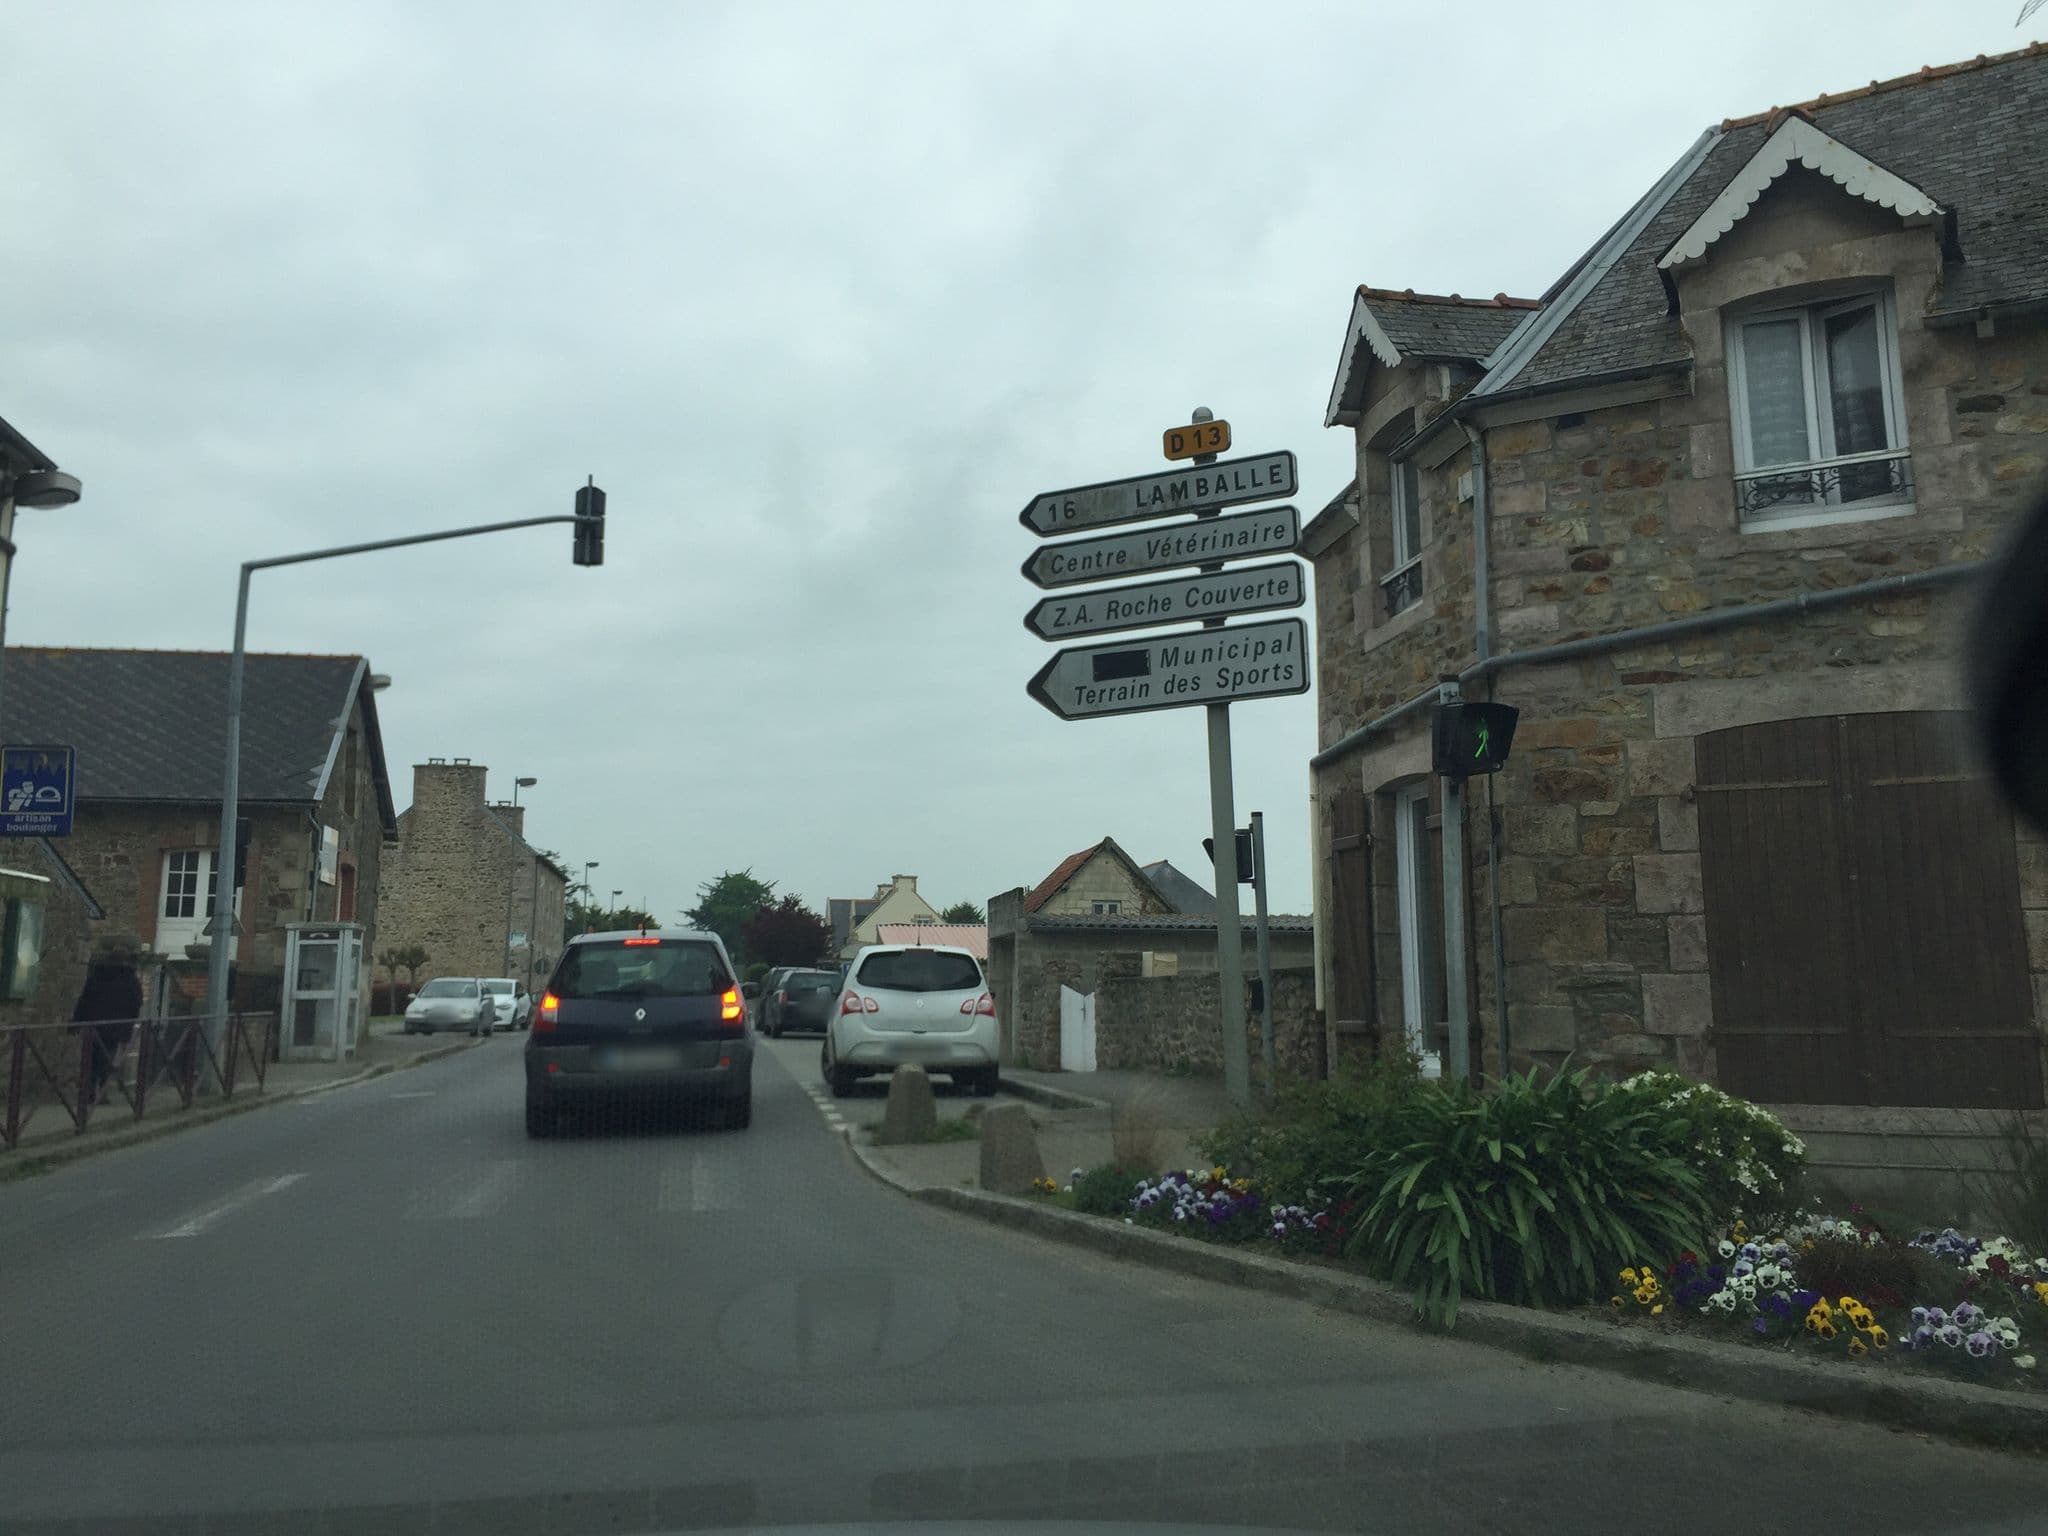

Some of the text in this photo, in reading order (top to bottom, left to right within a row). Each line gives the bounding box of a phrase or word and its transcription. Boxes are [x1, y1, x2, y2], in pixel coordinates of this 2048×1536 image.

[1171, 427, 1222, 453] D 13
[1048, 464, 1283, 523] 16 LAMBALLE
[1051, 523, 1286, 575] Centre Vétérinaire
[1053, 580, 1289, 629] Z.A. Roche Couverte
[1160, 631, 1293, 669] Municipal
[1074, 663, 1294, 706] Terrain des Sports
